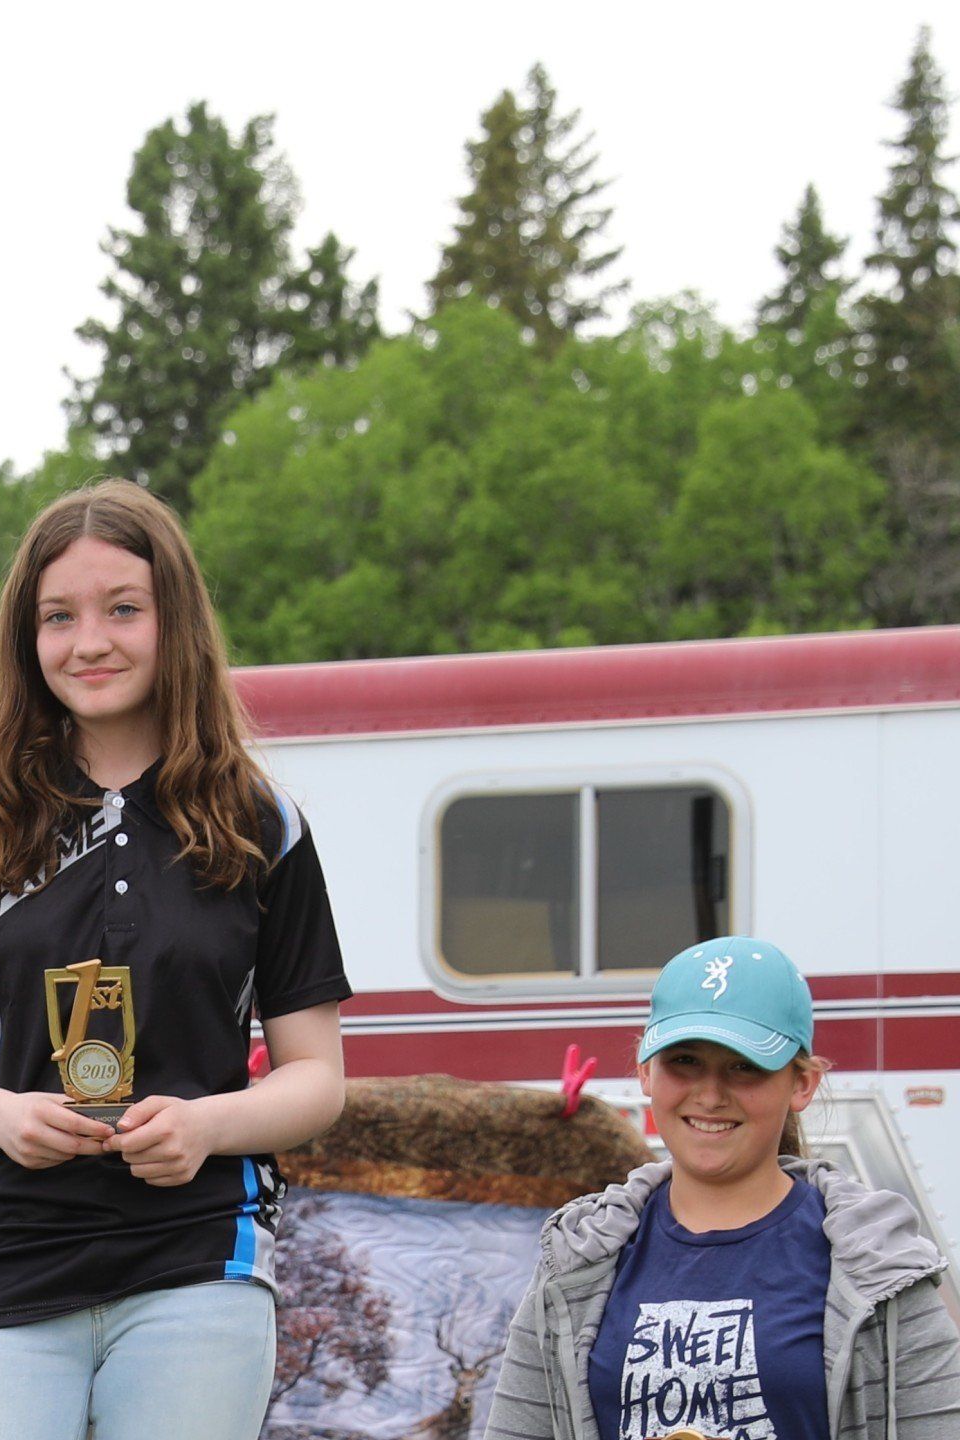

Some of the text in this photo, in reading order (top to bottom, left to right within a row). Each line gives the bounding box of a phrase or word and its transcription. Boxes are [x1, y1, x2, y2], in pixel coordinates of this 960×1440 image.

[81, 1063, 117, 1081] 2019
[628, 1307, 752, 1369] SWEET
[620, 1372, 767, 1435] HOME
